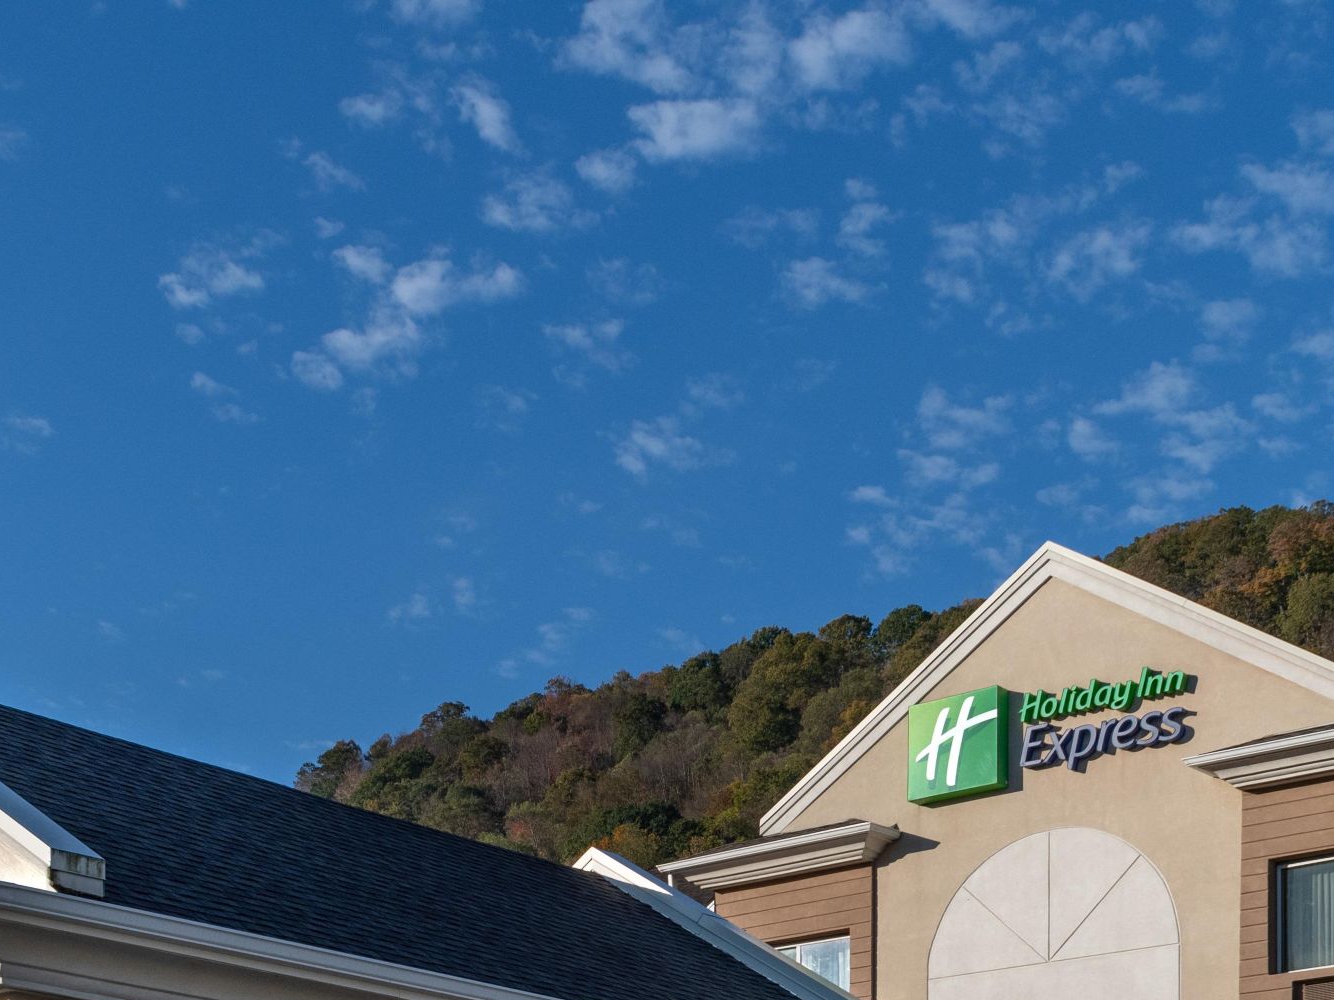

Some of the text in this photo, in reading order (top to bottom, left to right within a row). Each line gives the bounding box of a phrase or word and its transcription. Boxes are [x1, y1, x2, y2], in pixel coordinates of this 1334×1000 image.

[1019, 666, 1186, 722] Holiday Inn
[915, 695, 998, 787] H
[1019, 707, 1186, 771] Express
